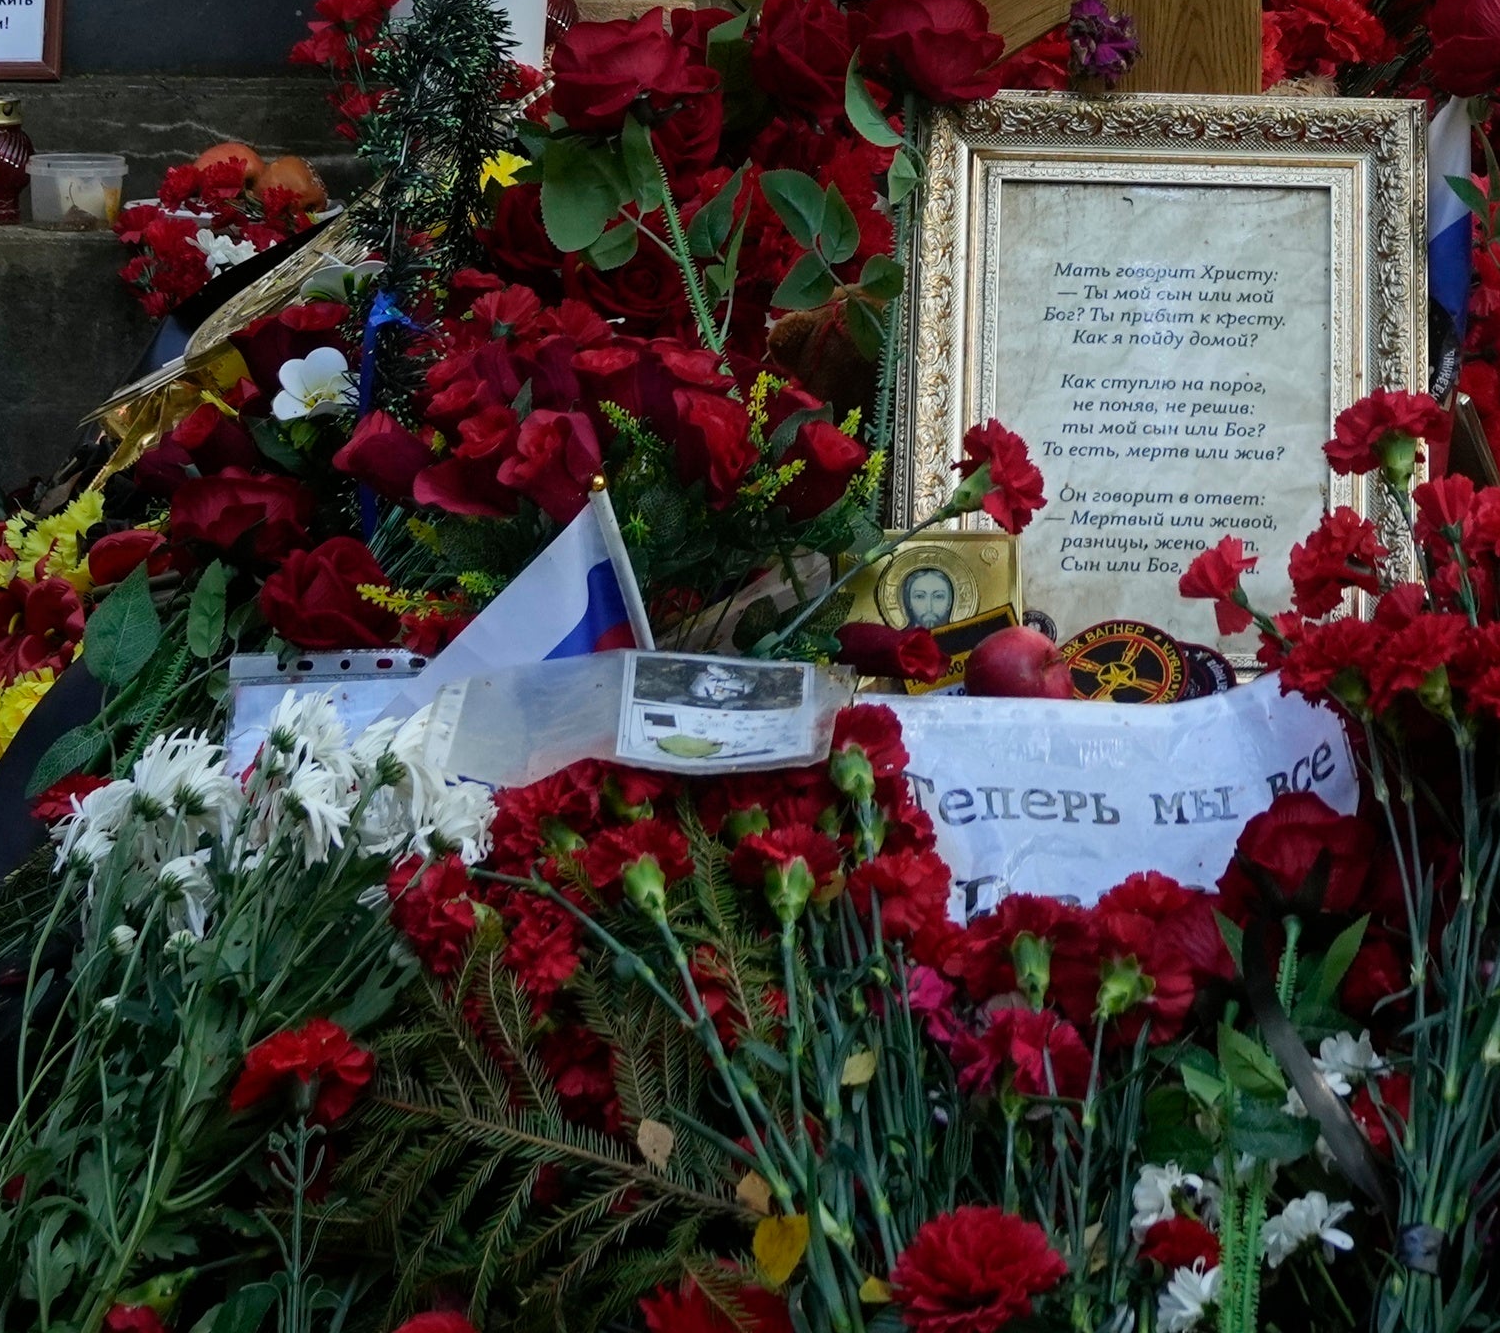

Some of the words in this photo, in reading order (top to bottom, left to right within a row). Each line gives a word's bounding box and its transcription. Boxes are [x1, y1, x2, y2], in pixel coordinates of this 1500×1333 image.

[1053, 262, 1111, 278] Мать
[1115, 267, 1196, 283] говорит
[1199, 265, 1278, 286] Христу:
[1083, 284, 1108, 300] Ты
[1113, 286, 1151, 300] мой
[1156, 290, 1192, 302] сын
[1198, 290, 1232, 303] или
[1236, 289, 1274, 304] мой
[1042, 306, 1086, 322] Бог?
[1089, 307, 1115, 322] Ты
[1120, 308, 1194, 327] прибит
[1200, 313, 1211, 324] к
[1216, 312, 1286, 331] кресту.
[1072, 329, 1108, 344] Как
[1111, 334, 1123, 345] я
[1128, 329, 1184, 350] пойду
[1189, 330, 1259, 348] домой?
[1060, 373, 1096, 389] Как
[1101, 378, 1177, 394] ступлю
[1182, 380, 1204, 391] на
[1209, 381, 1266, 397] порог,
[1073, 400, 1094, 412] не
[1099, 400, 1158, 414] поняв,
[1165, 402, 1187, 413] не
[1189, 402, 1255, 418] решив:
[1061, 423, 1094, 434] ты
[1098, 420, 1137, 435] мой
[1142, 424, 1179, 436] сын
[1184, 425, 1219, 437] или
[1224, 421, 1266, 438] Бог?
[1042, 441, 1064, 457] То
[1068, 445, 1120, 459] есть,
[1126, 446, 1190, 462] мертв
[1195, 448, 1229, 460] или
[1234, 446, 1285, 461] жив?
[1059, 487, 1087, 503] Он
[1092, 491, 1174, 508] говорит
[1179, 493, 1189, 504] в
[1194, 493, 1266, 506] ответ:
[1070, 510, 1164, 530] Мертвый
[1170, 515, 1204, 527] или
[1209, 514, 1277, 531] живой,
[1060, 537, 1149, 553] разницы,
[1060, 555, 1101, 572] Сын
[1106, 560, 1141, 572] или
[1146, 556, 1182, 575] Бог,
[1085, 623, 1145, 642] ВАГНЕР
[901, 770, 1120, 825] Теперь
[1149, 785, 1238, 824] мы
